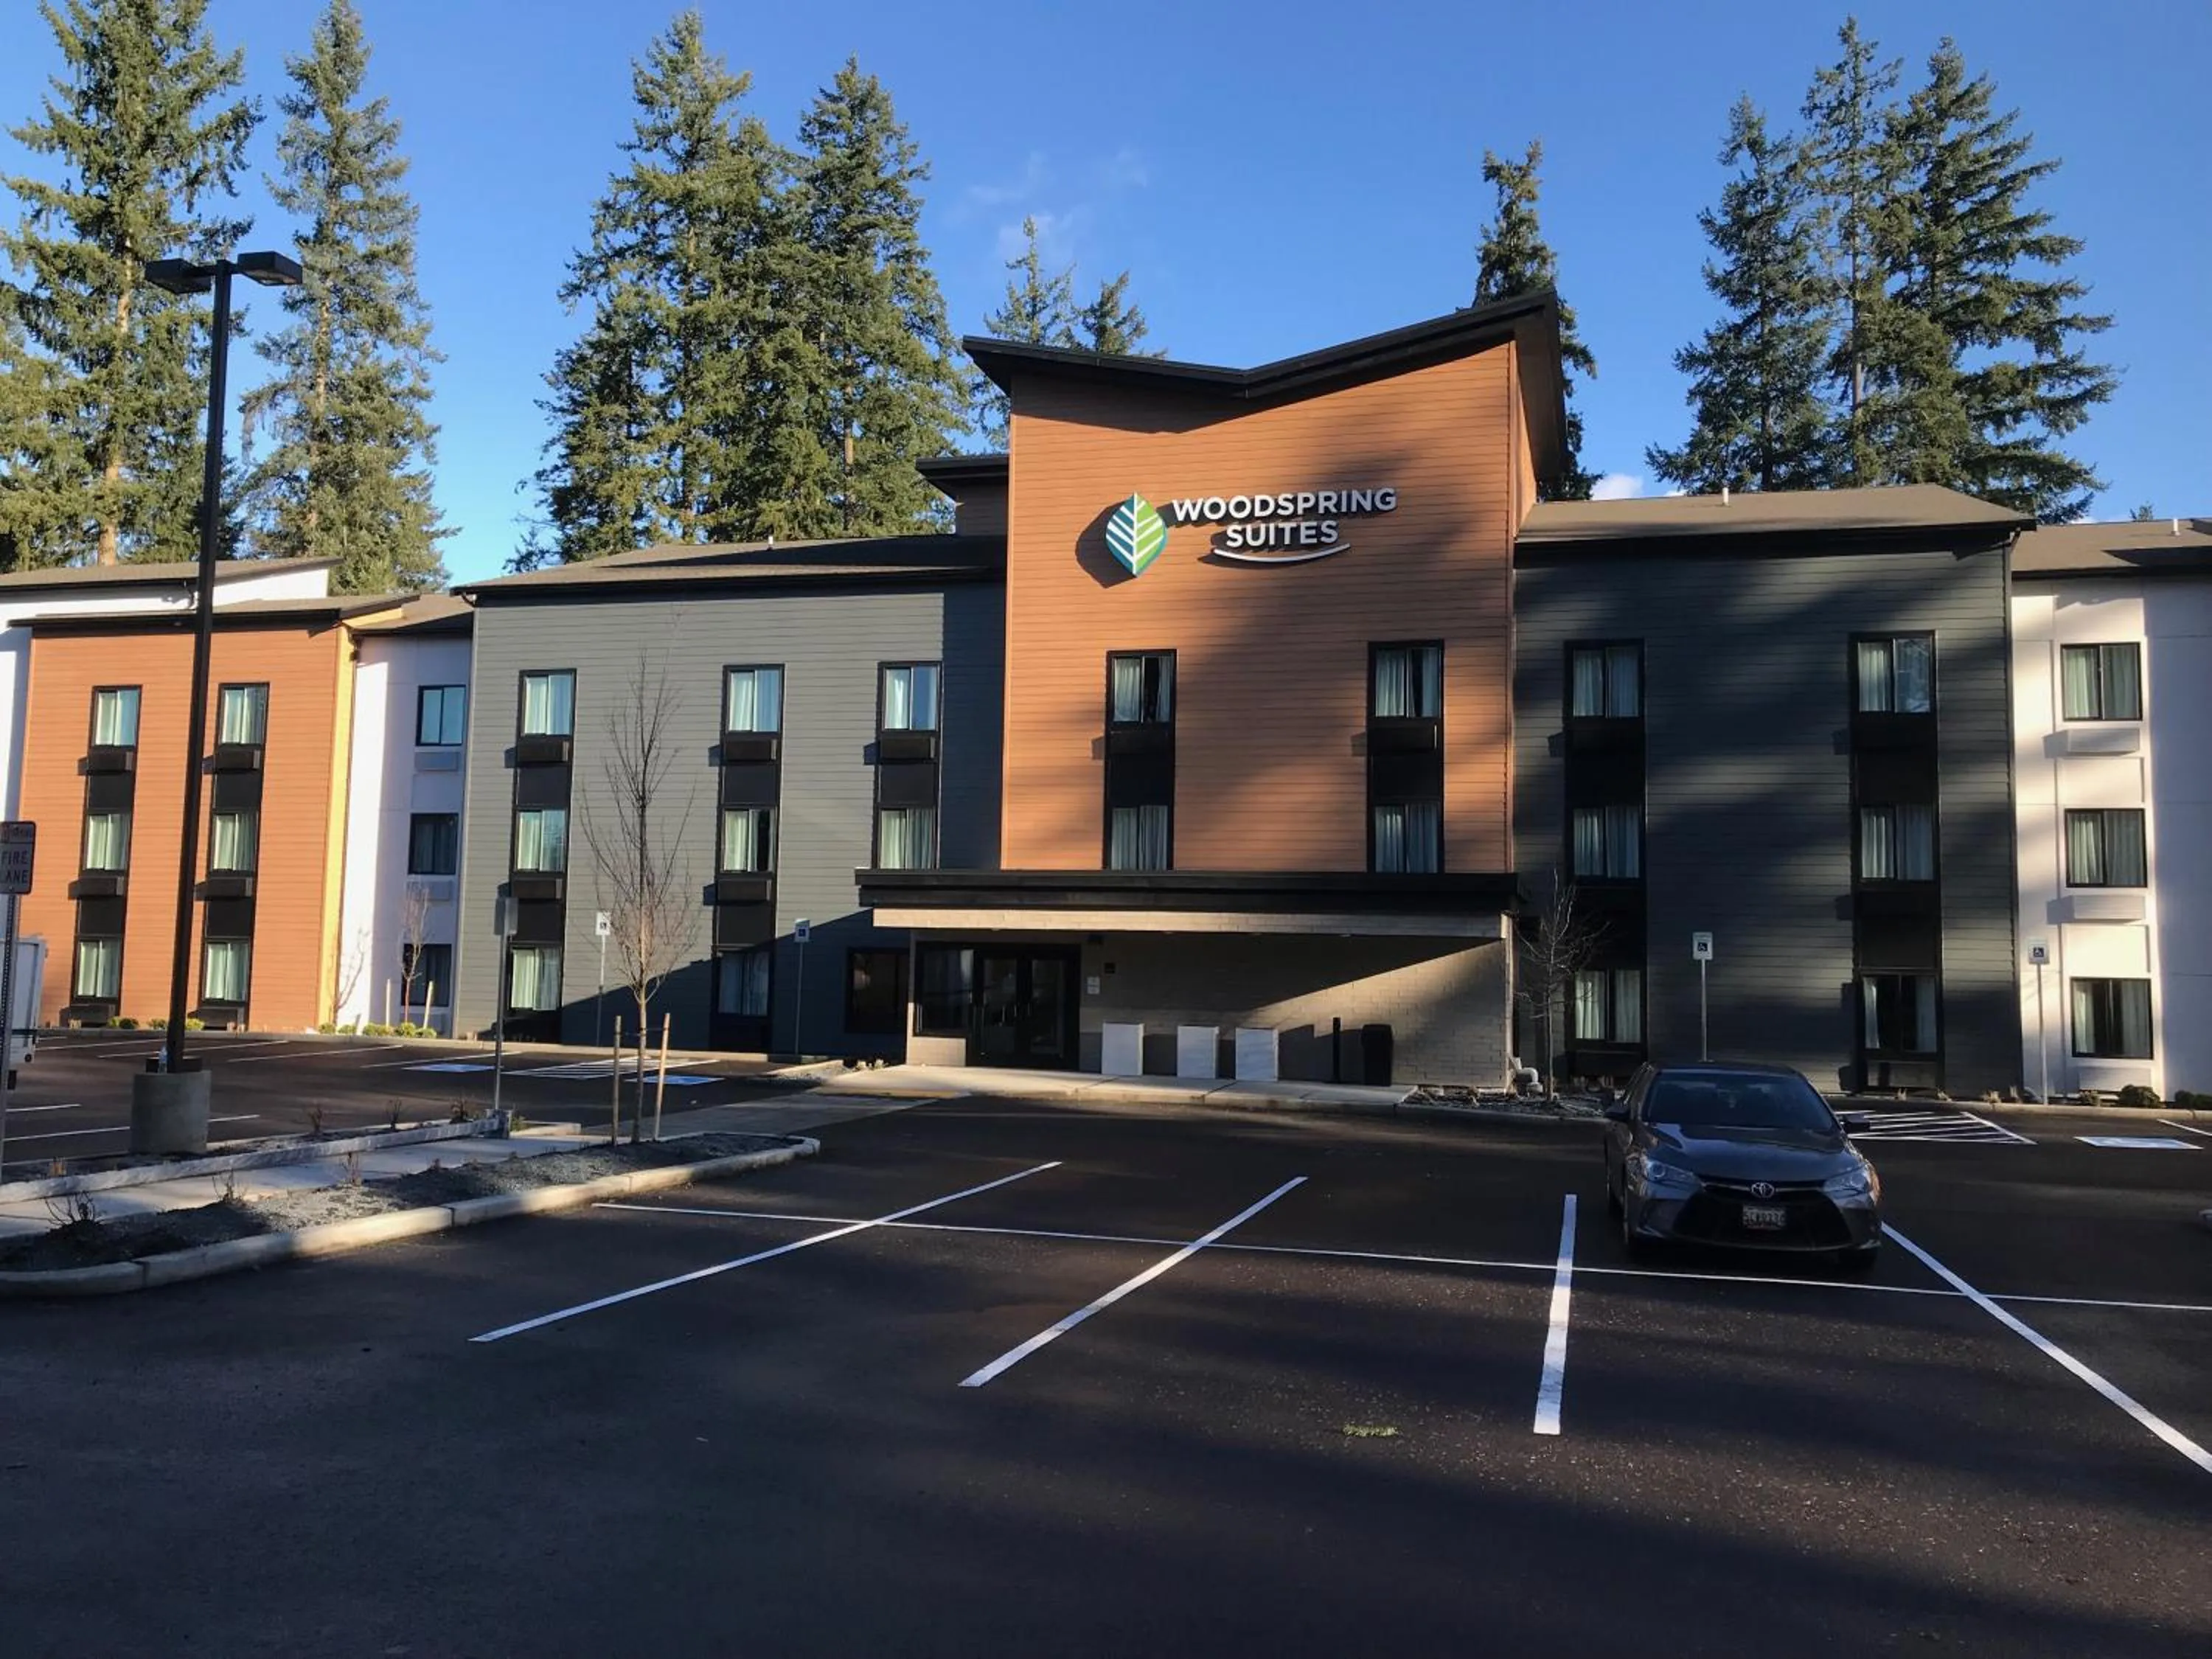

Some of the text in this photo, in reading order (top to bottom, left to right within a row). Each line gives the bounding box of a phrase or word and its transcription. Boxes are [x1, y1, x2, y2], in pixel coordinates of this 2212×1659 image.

[1172, 487, 1397, 521] WOODSPRING
[1226, 521, 1338, 548] SUITES
[1, 849, 28, 865] FIRE
